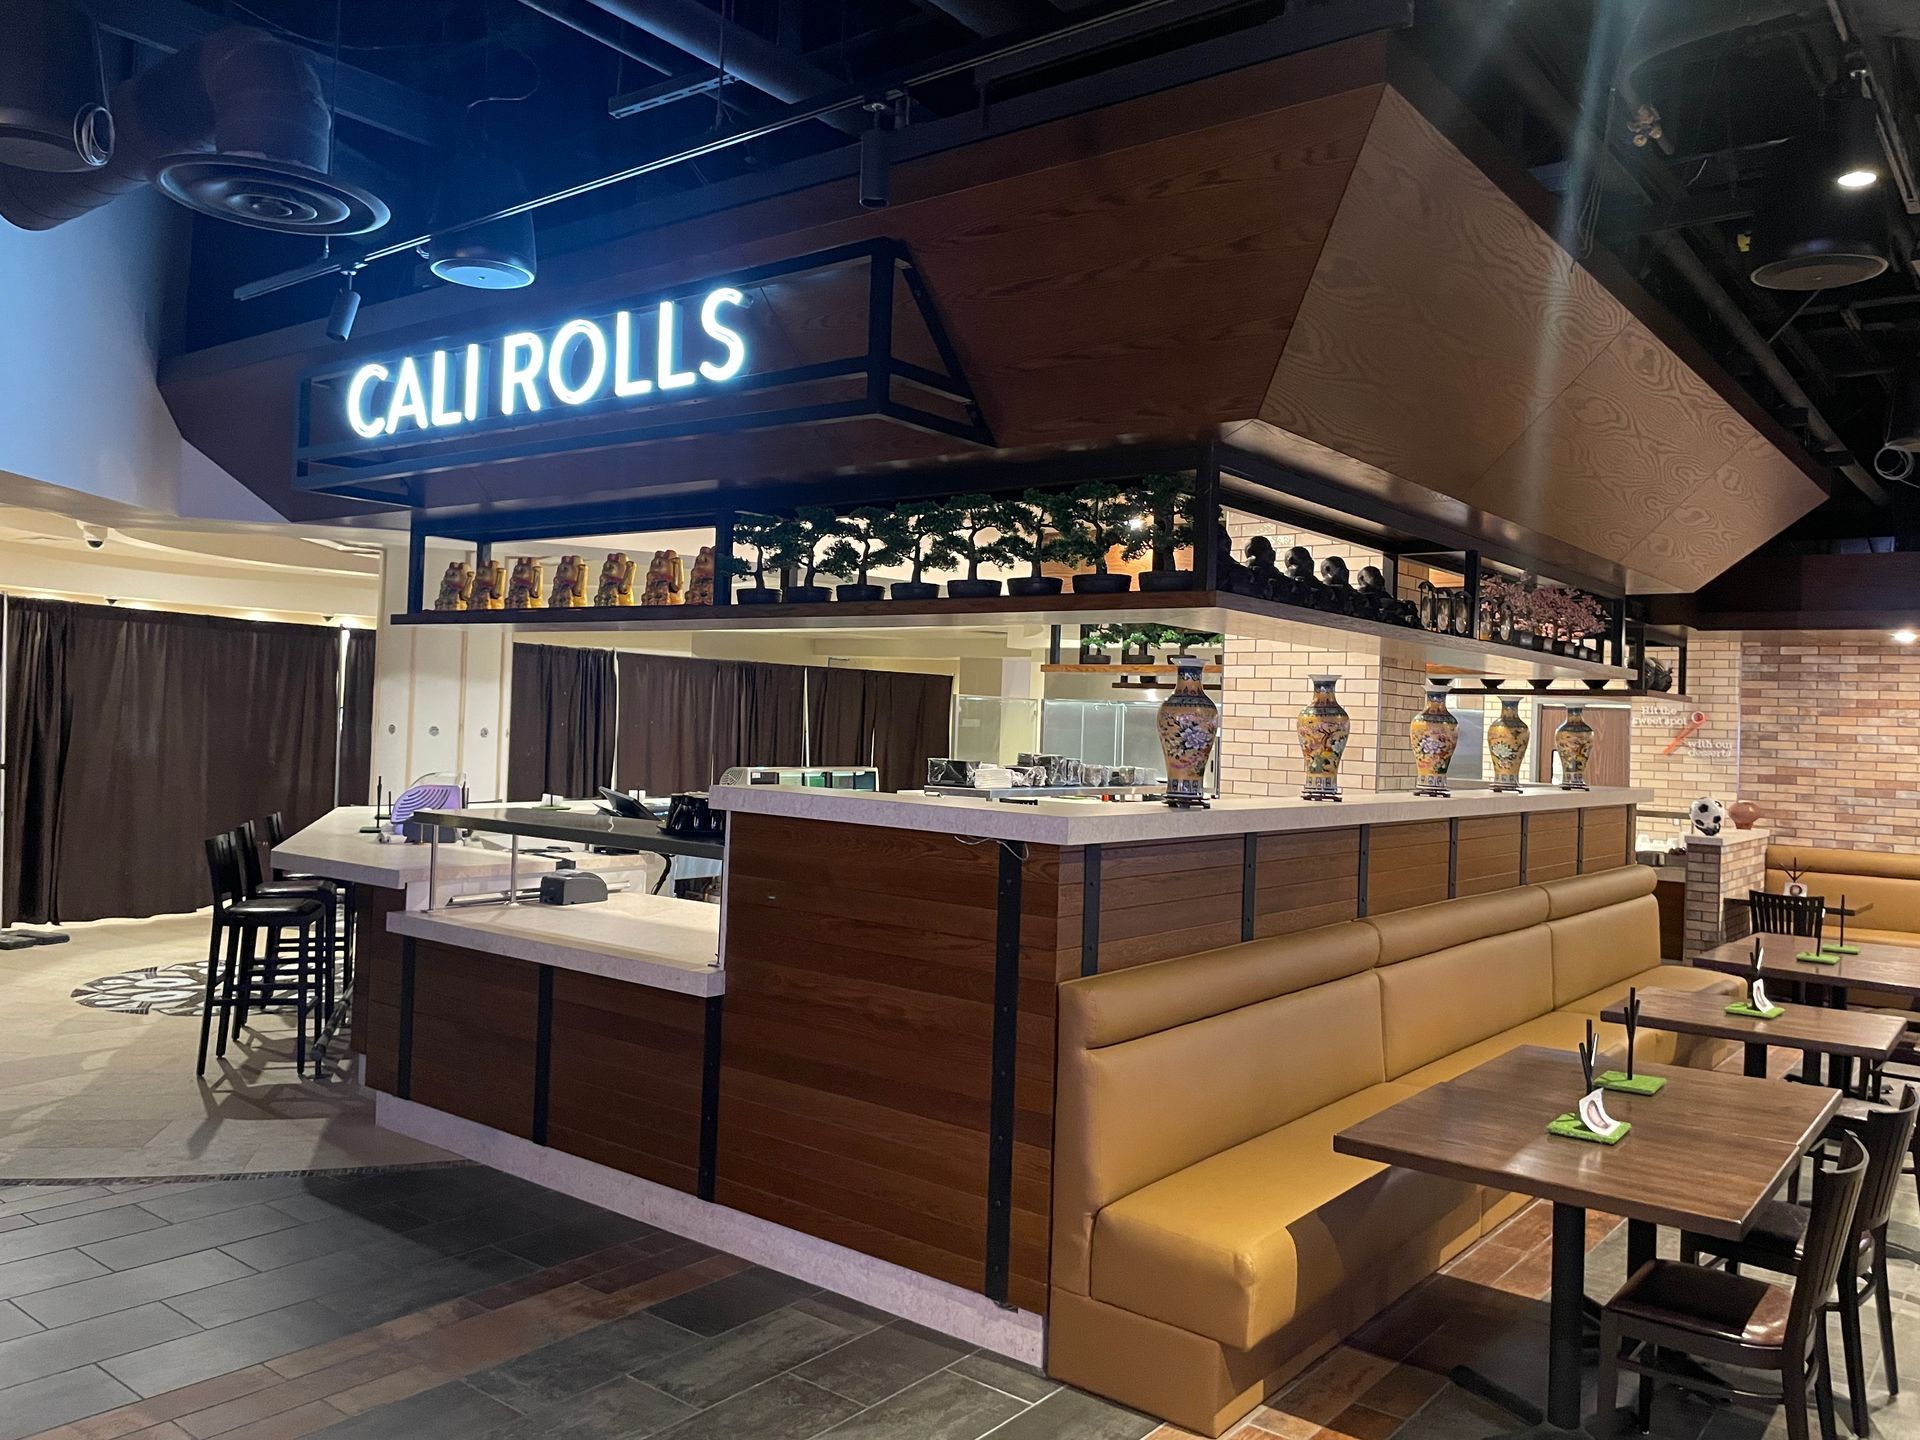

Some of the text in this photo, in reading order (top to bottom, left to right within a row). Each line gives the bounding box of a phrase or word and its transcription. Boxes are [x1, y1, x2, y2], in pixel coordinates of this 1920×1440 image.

[346, 287, 746, 438] CALI ROLLS
[1640, 705, 1659, 715] Hit
[1688, 739, 1713, 749] with
